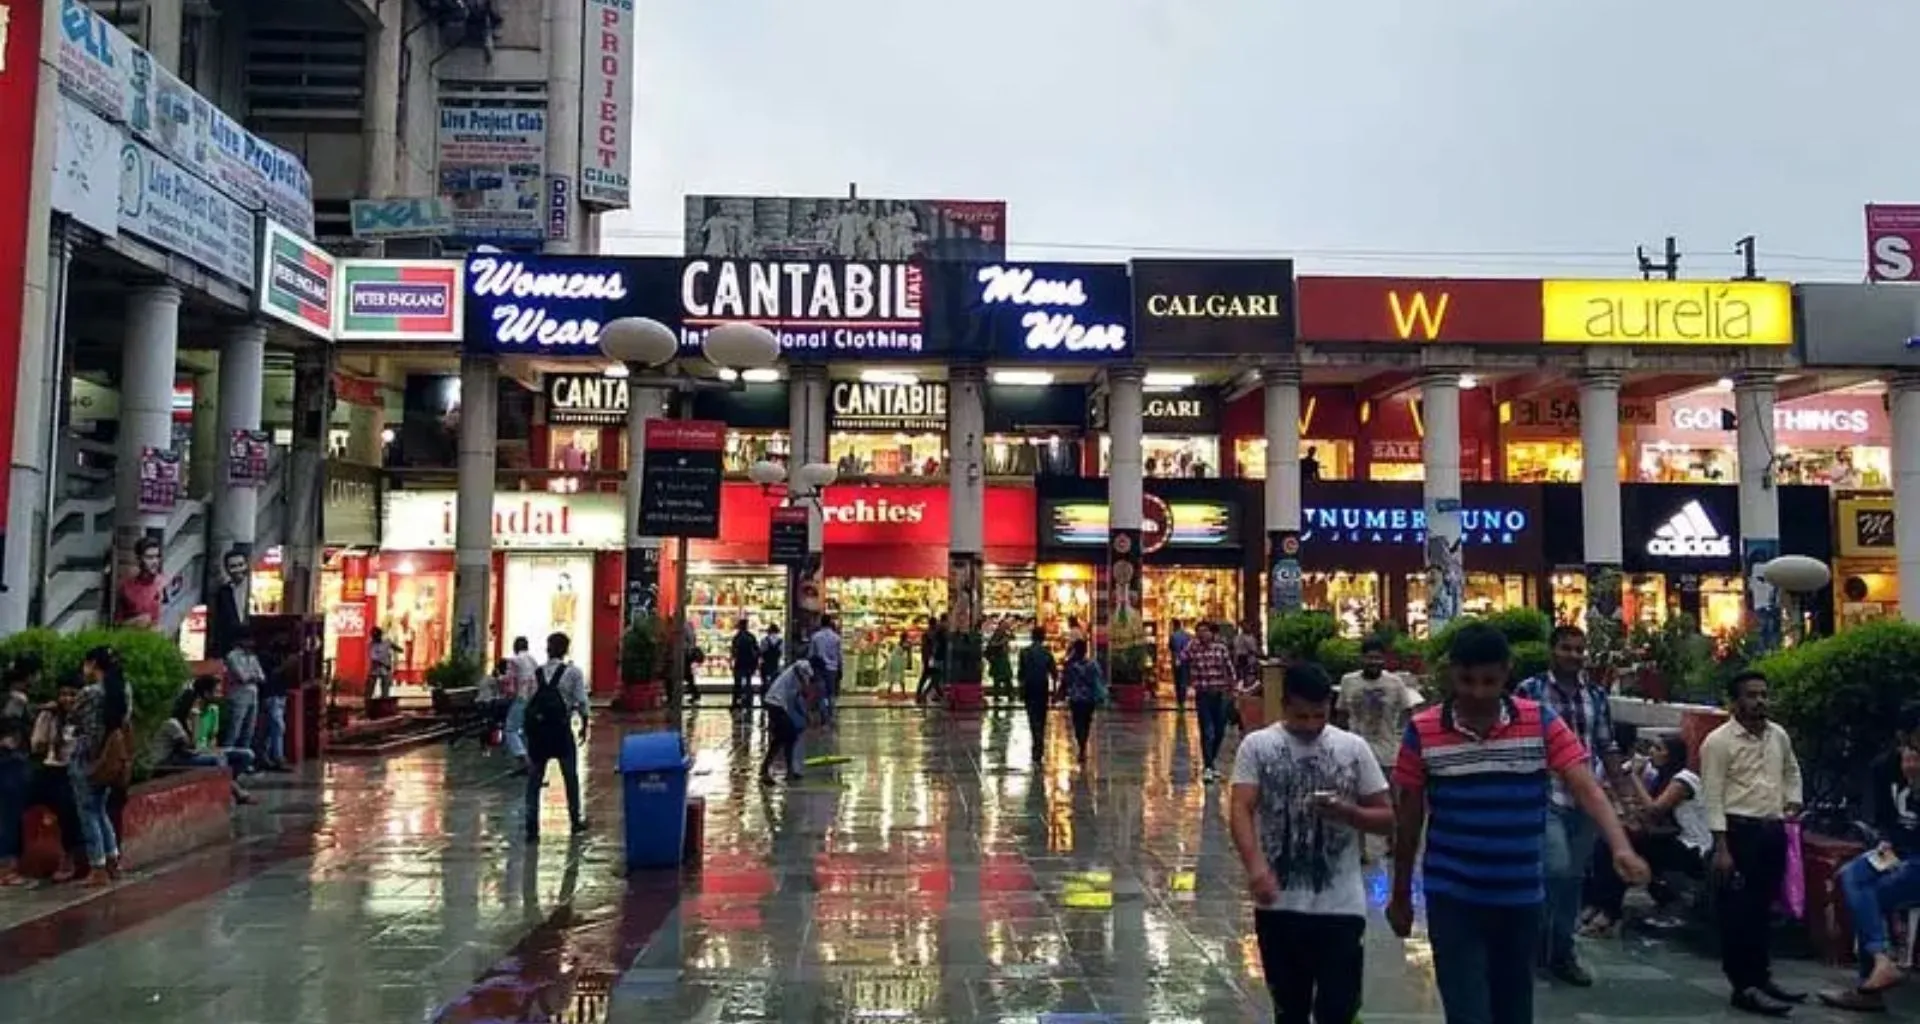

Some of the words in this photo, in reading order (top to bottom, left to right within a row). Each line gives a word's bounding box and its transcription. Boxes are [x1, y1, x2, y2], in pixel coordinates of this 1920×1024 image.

[441, 110, 465, 128] Live
[469, 110, 512, 136] Project
[517, 112, 543, 132] Club
[585, 167, 628, 186] Club
[470, 257, 627, 299] Womens
[682, 261, 921, 318] CANTABIL
[977, 265, 1088, 305] Mens
[355, 291, 387, 307] PETER
[388, 291, 445, 307] ENGLAND
[1147, 294, 1279, 317] CALGARI
[491, 304, 600, 344] Wear
[1389, 291, 1448, 339] W
[834, 329, 923, 351] Clothing
[1021, 311, 1126, 351] Wear
[552, 377, 630, 409] CANTA
[1142, 399, 1200, 417] GARI
[1773, 408, 1869, 433] THINGS
[822, 499, 924, 523] rchies
[1319, 509, 1426, 530] NUMER
[1462, 510, 1525, 531] UNO
[1648, 534, 1731, 556] adidas
